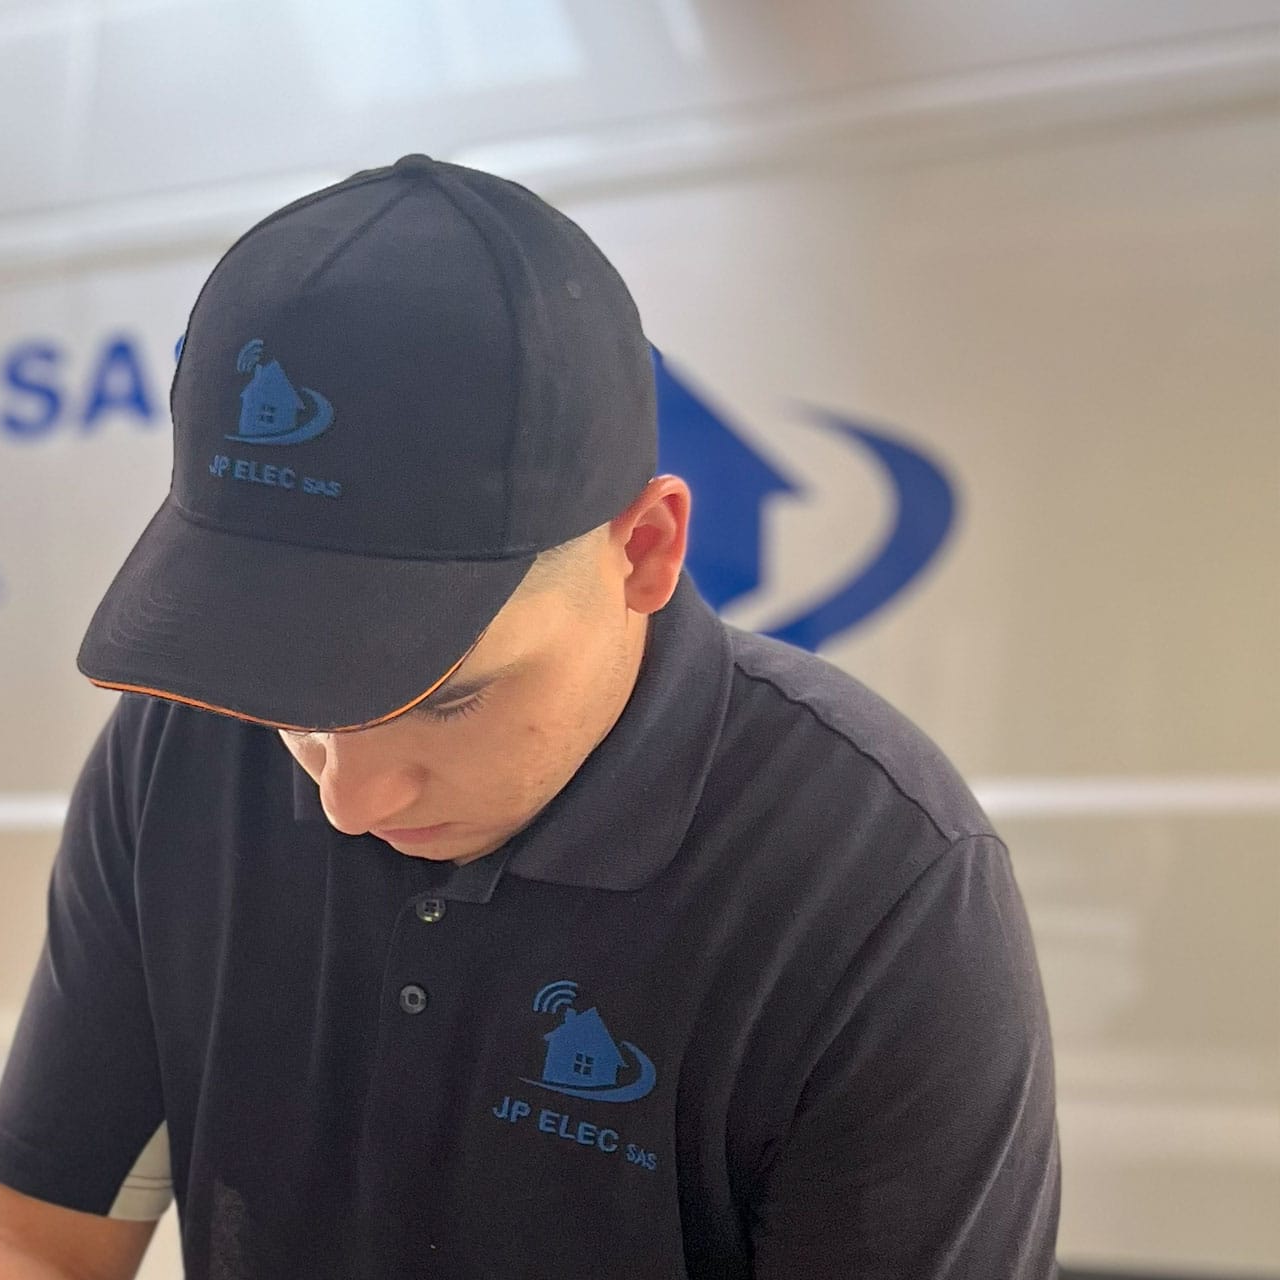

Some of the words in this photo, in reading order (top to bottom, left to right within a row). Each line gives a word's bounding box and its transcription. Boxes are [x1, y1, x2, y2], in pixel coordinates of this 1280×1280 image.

[209, 454, 230, 478] JP
[232, 459, 296, 490] ELEC
[303, 475, 342, 498] SAS
[492, 1096, 531, 1123] JP
[538, 1109, 620, 1153] ELEC
[626, 1143, 658, 1171] SAS
